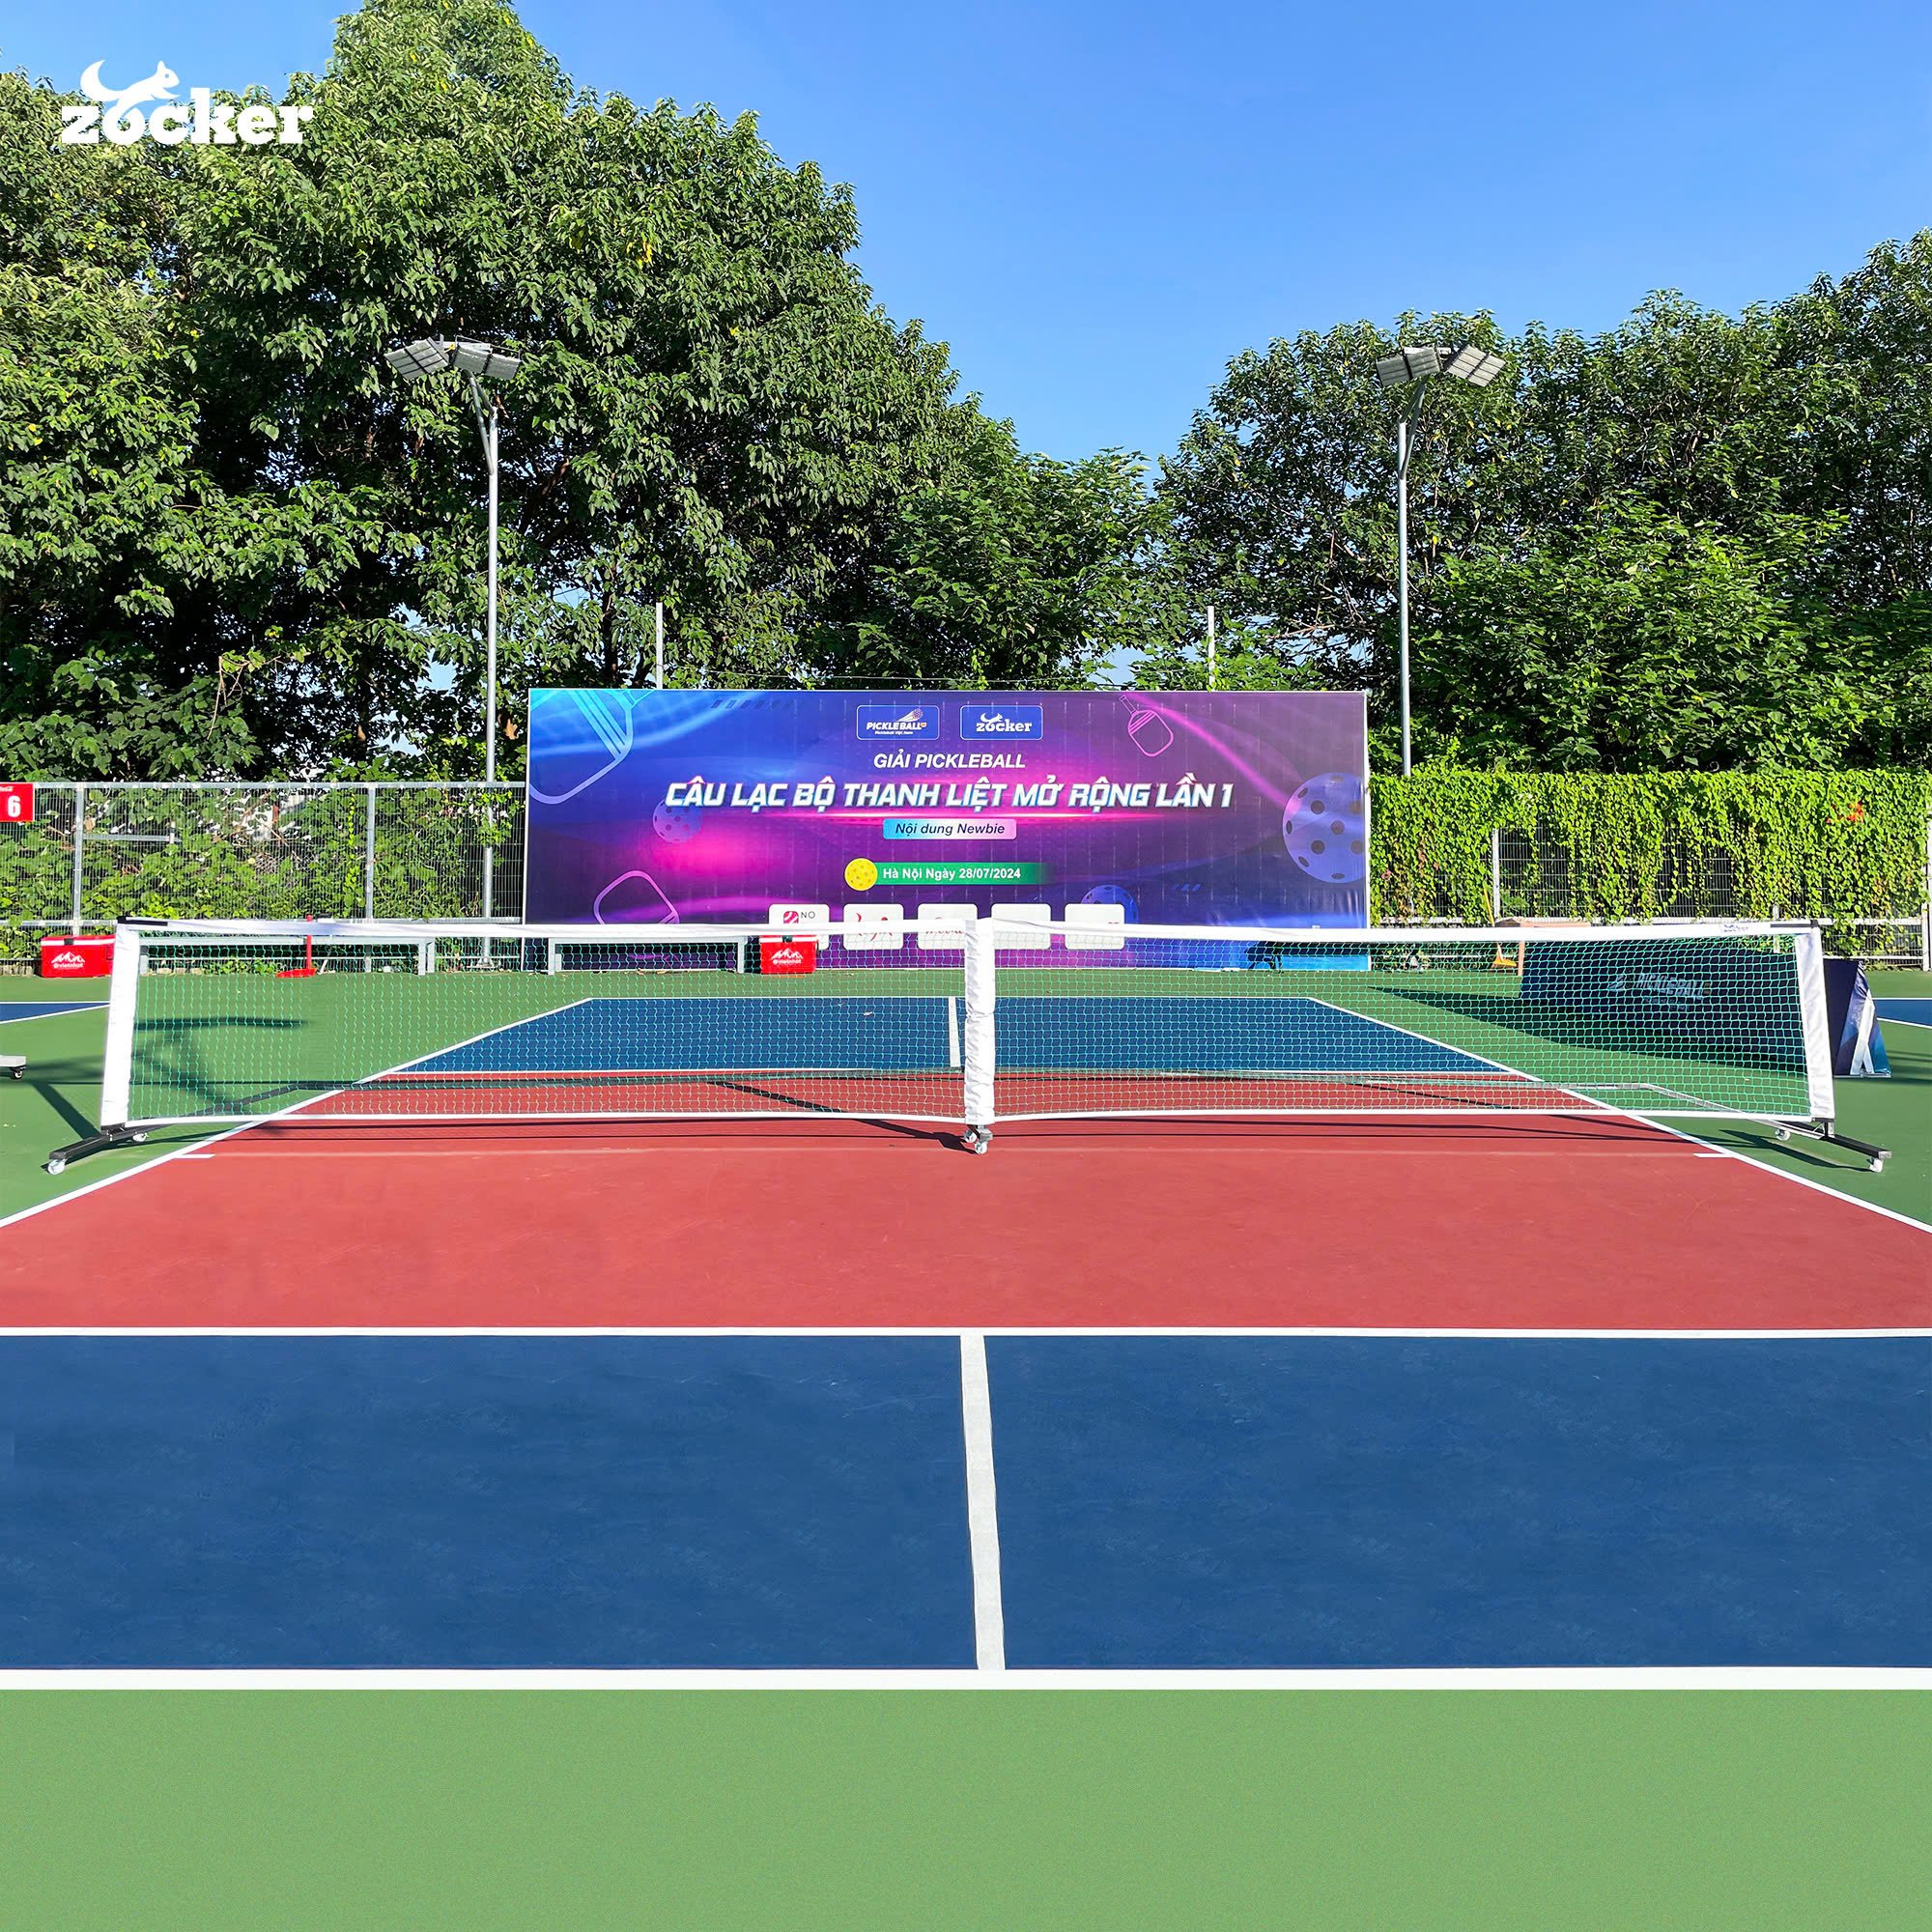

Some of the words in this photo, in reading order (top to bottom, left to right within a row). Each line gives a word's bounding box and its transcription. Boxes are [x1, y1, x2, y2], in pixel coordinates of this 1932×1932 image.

[867, 722, 923, 730] PICKLEBALL
[976, 719, 1033, 732] zocker
[873, 749, 911, 769] GIẢI
[914, 753, 1026, 769] PICKLEBALL
[665, 775, 726, 807] CÂU
[730, 782, 788, 813] LẠC
[792, 775, 837, 813] BỘ
[843, 782, 941, 808] THANH
[945, 776, 1008, 813] LIỆT
[1011, 774, 1065, 808] MỞ
[1068, 776, 1152, 813] RỘNG
[1154, 773, 1217, 808] LẦN
[1220, 782, 1236, 809] 1
[8, 795, 21, 818] 6
[895, 823, 917, 837] Nội
[921, 823, 953, 837] dung
[956, 823, 1006, 835] Newbie
[883, 867, 899, 879] Hà
[902, 867, 923, 880] Nội
[925, 867, 956, 882] Ngày
[959, 867, 1021, 879] 28/07/2024
